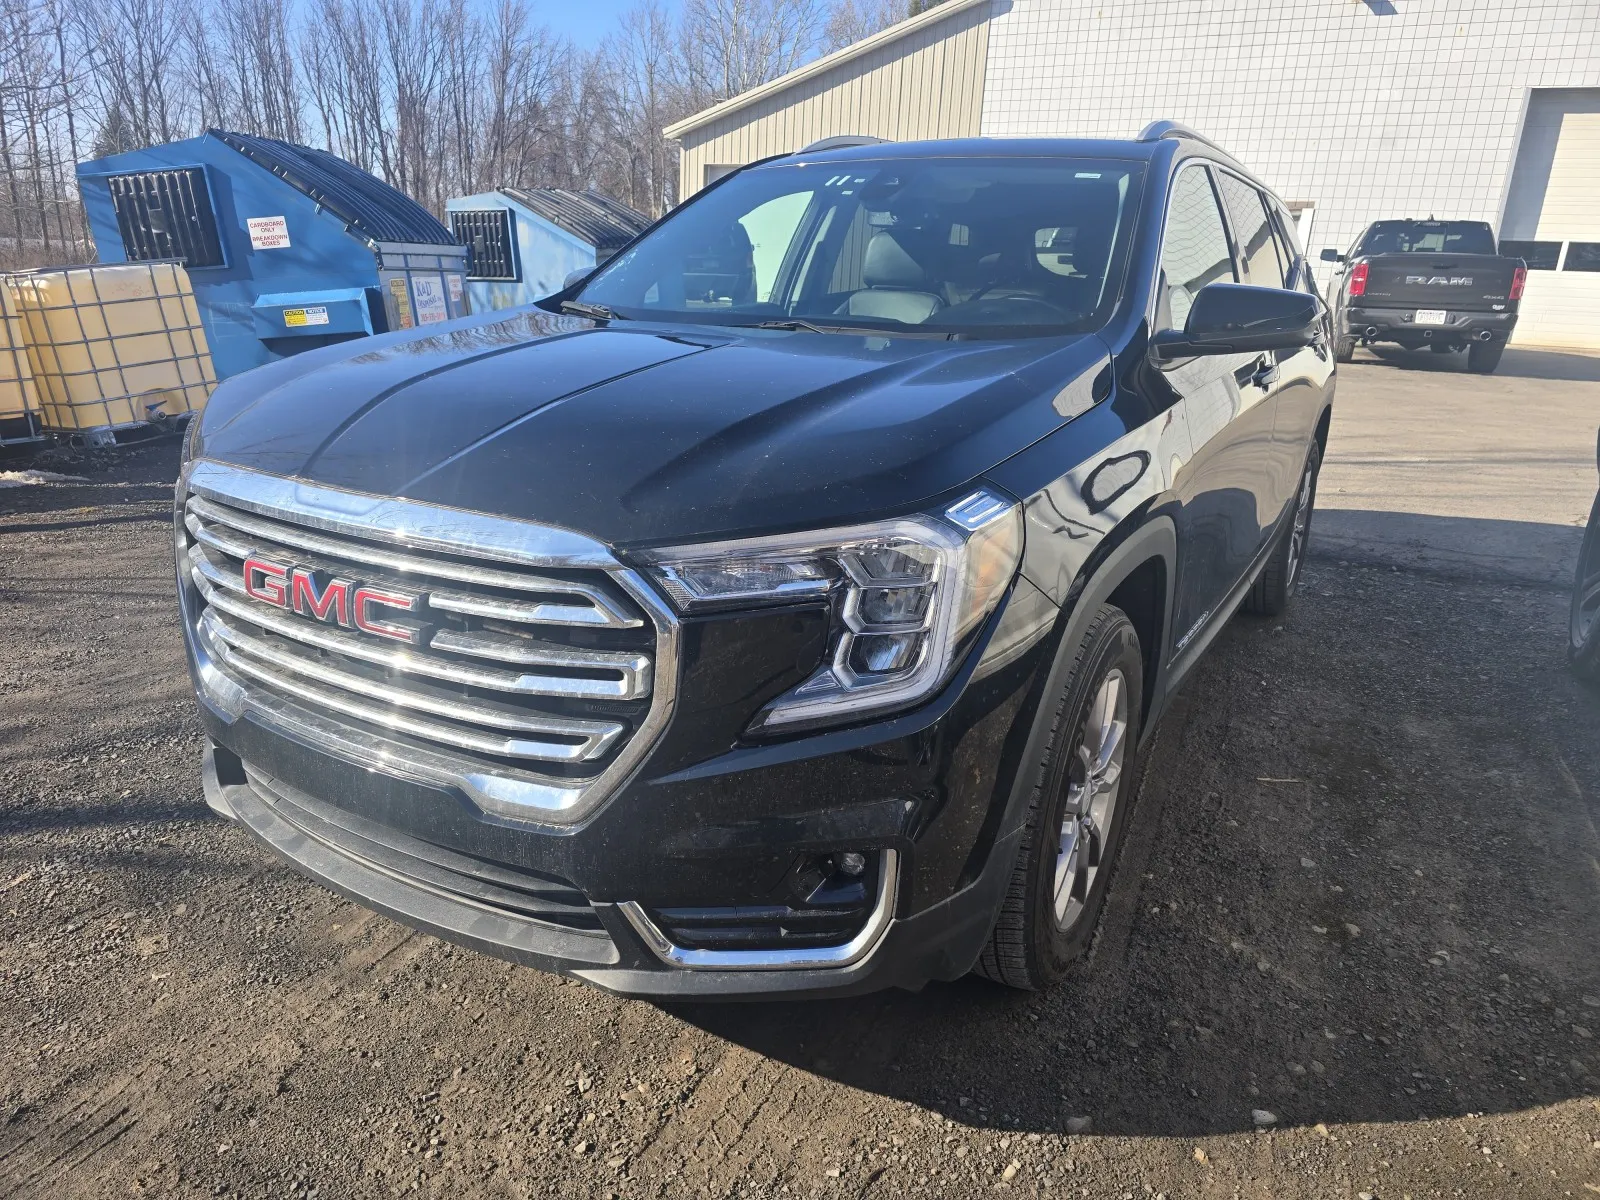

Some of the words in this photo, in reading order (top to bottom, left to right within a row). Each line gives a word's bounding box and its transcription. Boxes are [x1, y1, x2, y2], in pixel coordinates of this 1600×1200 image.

[250, 221, 284, 229] CARDBOARD
[252, 234, 288, 242] BREAKDOWN
[1405, 275, 1474, 286] RAM
[243, 557, 419, 644] GMC
